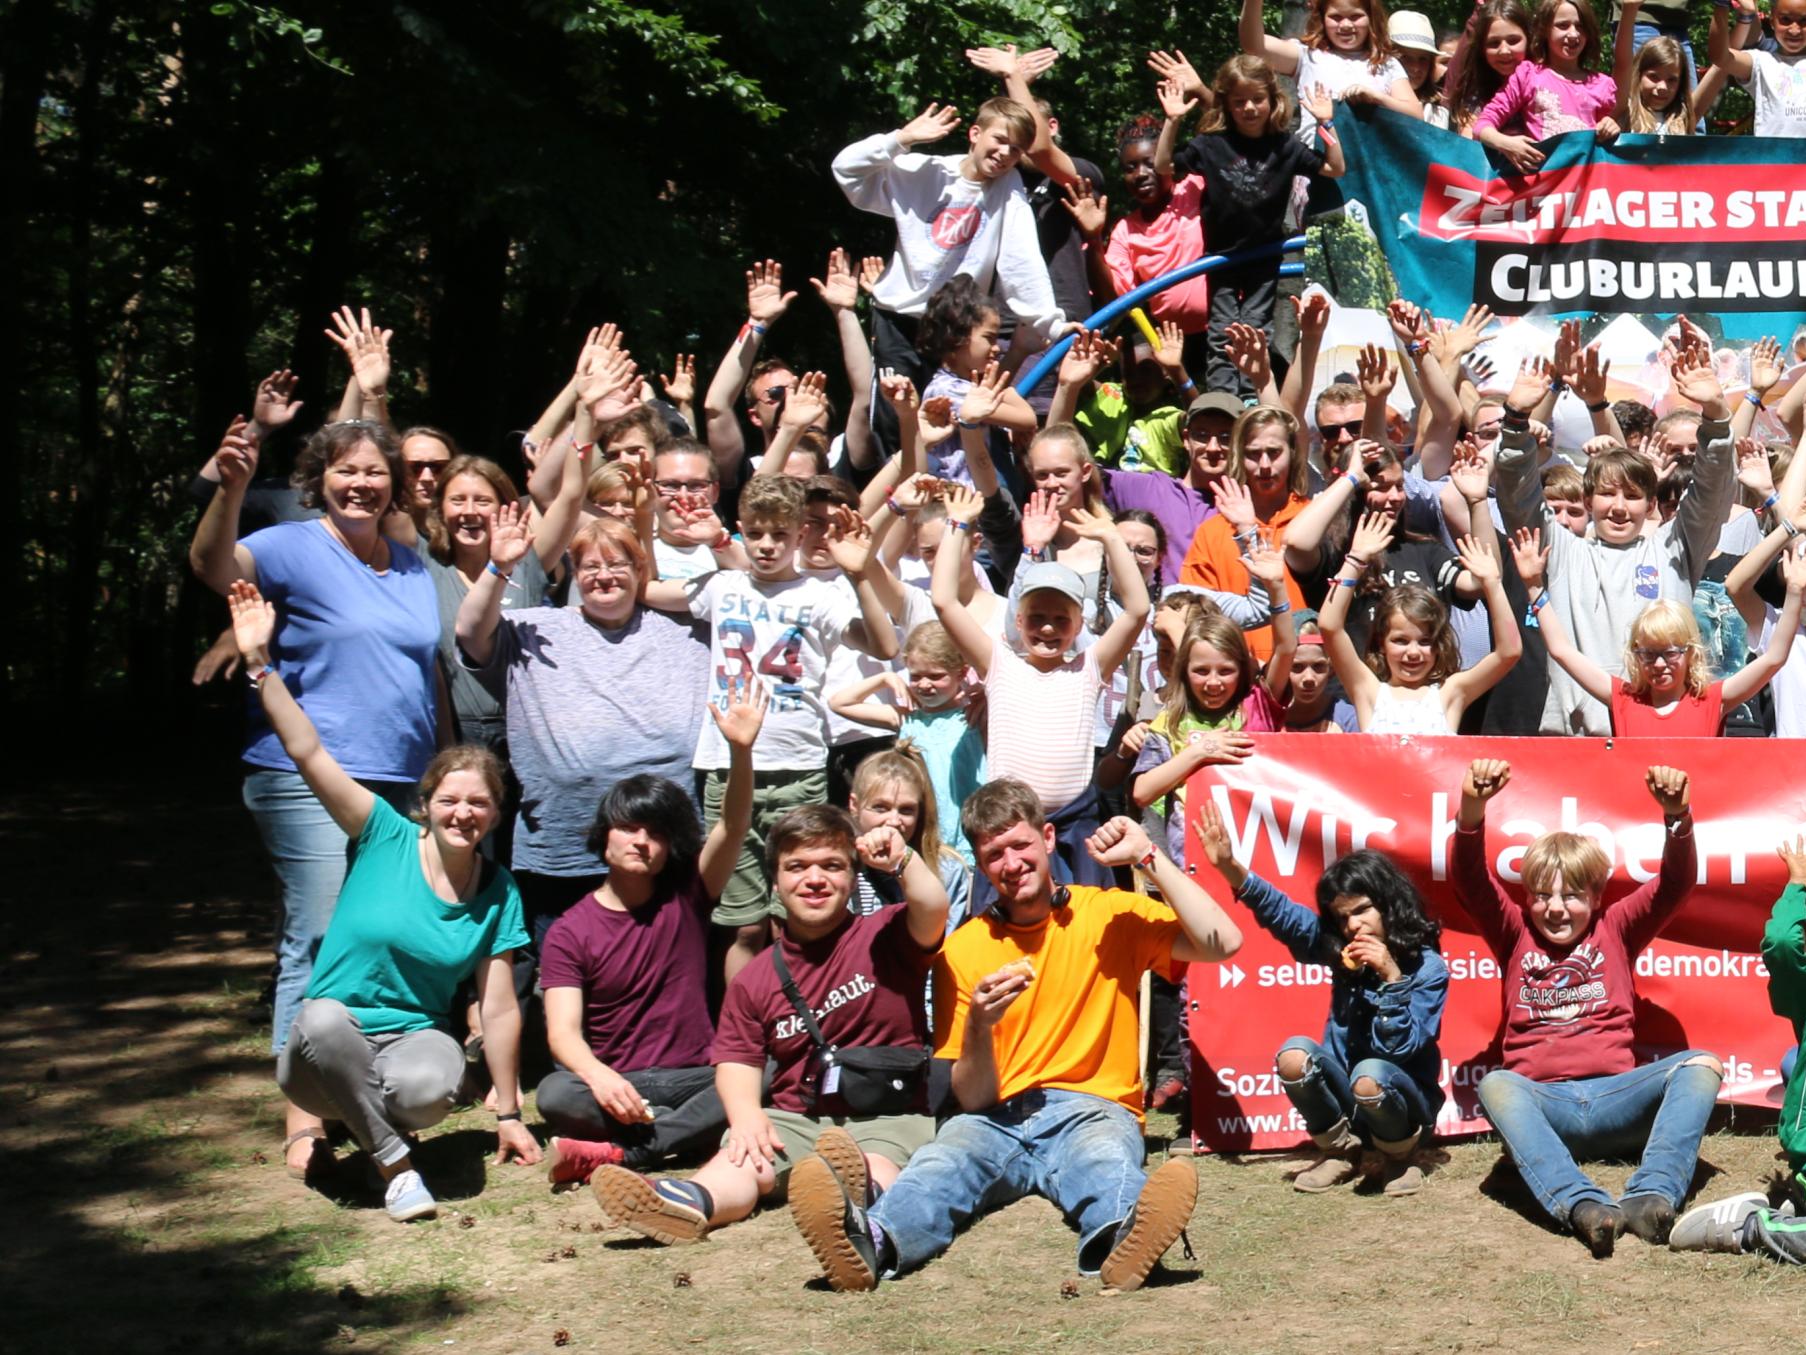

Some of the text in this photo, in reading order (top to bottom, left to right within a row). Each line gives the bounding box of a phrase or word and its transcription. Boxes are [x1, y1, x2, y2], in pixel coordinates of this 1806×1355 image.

[1438, 184, 1717, 230] ZELTLAGER
[720, 593, 814, 627] SKATE
[716, 617, 804, 696] 34
[1210, 785, 1398, 877] Wir
[1431, 792, 1747, 885] haben
[1635, 947, 1772, 977] demokra
[1216, 1065, 1287, 1097] Sozi
[1217, 1106, 1308, 1135] www.fa
